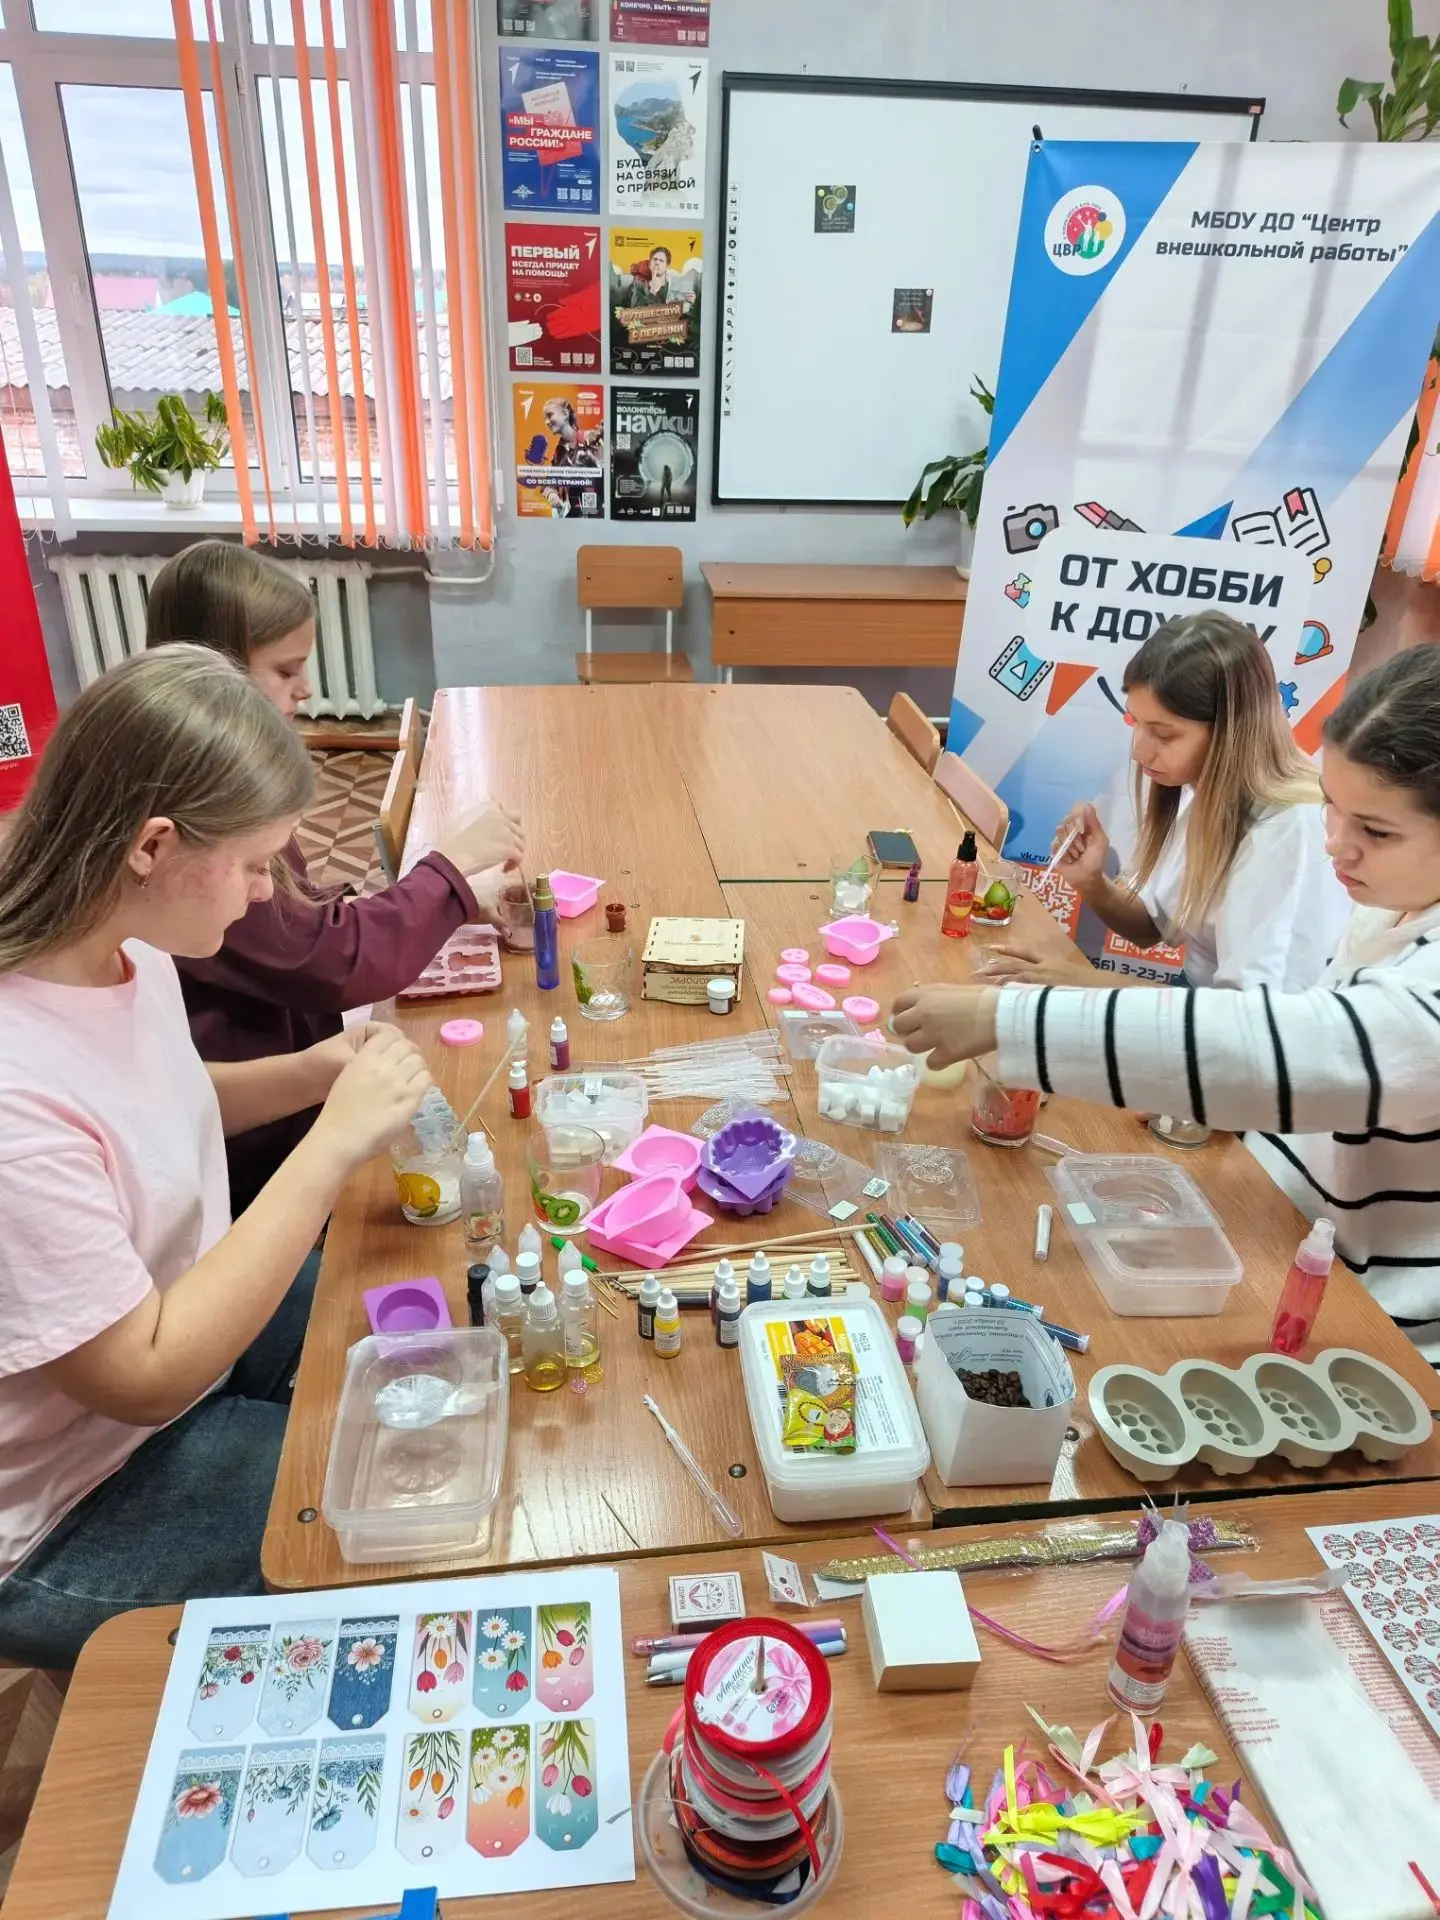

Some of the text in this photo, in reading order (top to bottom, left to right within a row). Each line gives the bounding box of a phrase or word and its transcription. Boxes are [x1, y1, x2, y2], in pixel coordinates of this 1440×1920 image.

[620, 1, 653, 11] КОНЕЧНО,
[676, 5, 708, 13] ПЕРВЫМ!
[508, 115, 534, 126] «МЫ
[530, 127, 593, 140] ГРАЖДАНЕ
[509, 136, 564, 148] РОССИИ!»
[616, 158, 649, 169] БУДЬ
[616, 168, 677, 181] НА СВЯЗИ
[616, 176, 696, 194] С ПРИРОДОЙ
[1190, 210, 1256, 231] МБОУ
[1259, 211, 1295, 233] ДО
[510, 244, 580, 260] ПЕРВЫЙ
[1052, 243, 1082, 258] ЦВР
[1155, 240, 1304, 260] внешкольной
[511, 260, 580, 271] ВСЕГДА ПРИДЕТ
[511, 268, 569, 278] НА ПОМОЩЬ!
[632, 324, 684, 339] С ПЕРВЫМИ
[538, 477, 557, 485] ВСЕЙ
[557, 478, 593, 486] СТРАНОЙ!
[1059, 553, 1284, 608] ОТ ХОББИ
[1050, 601, 1080, 633] К
